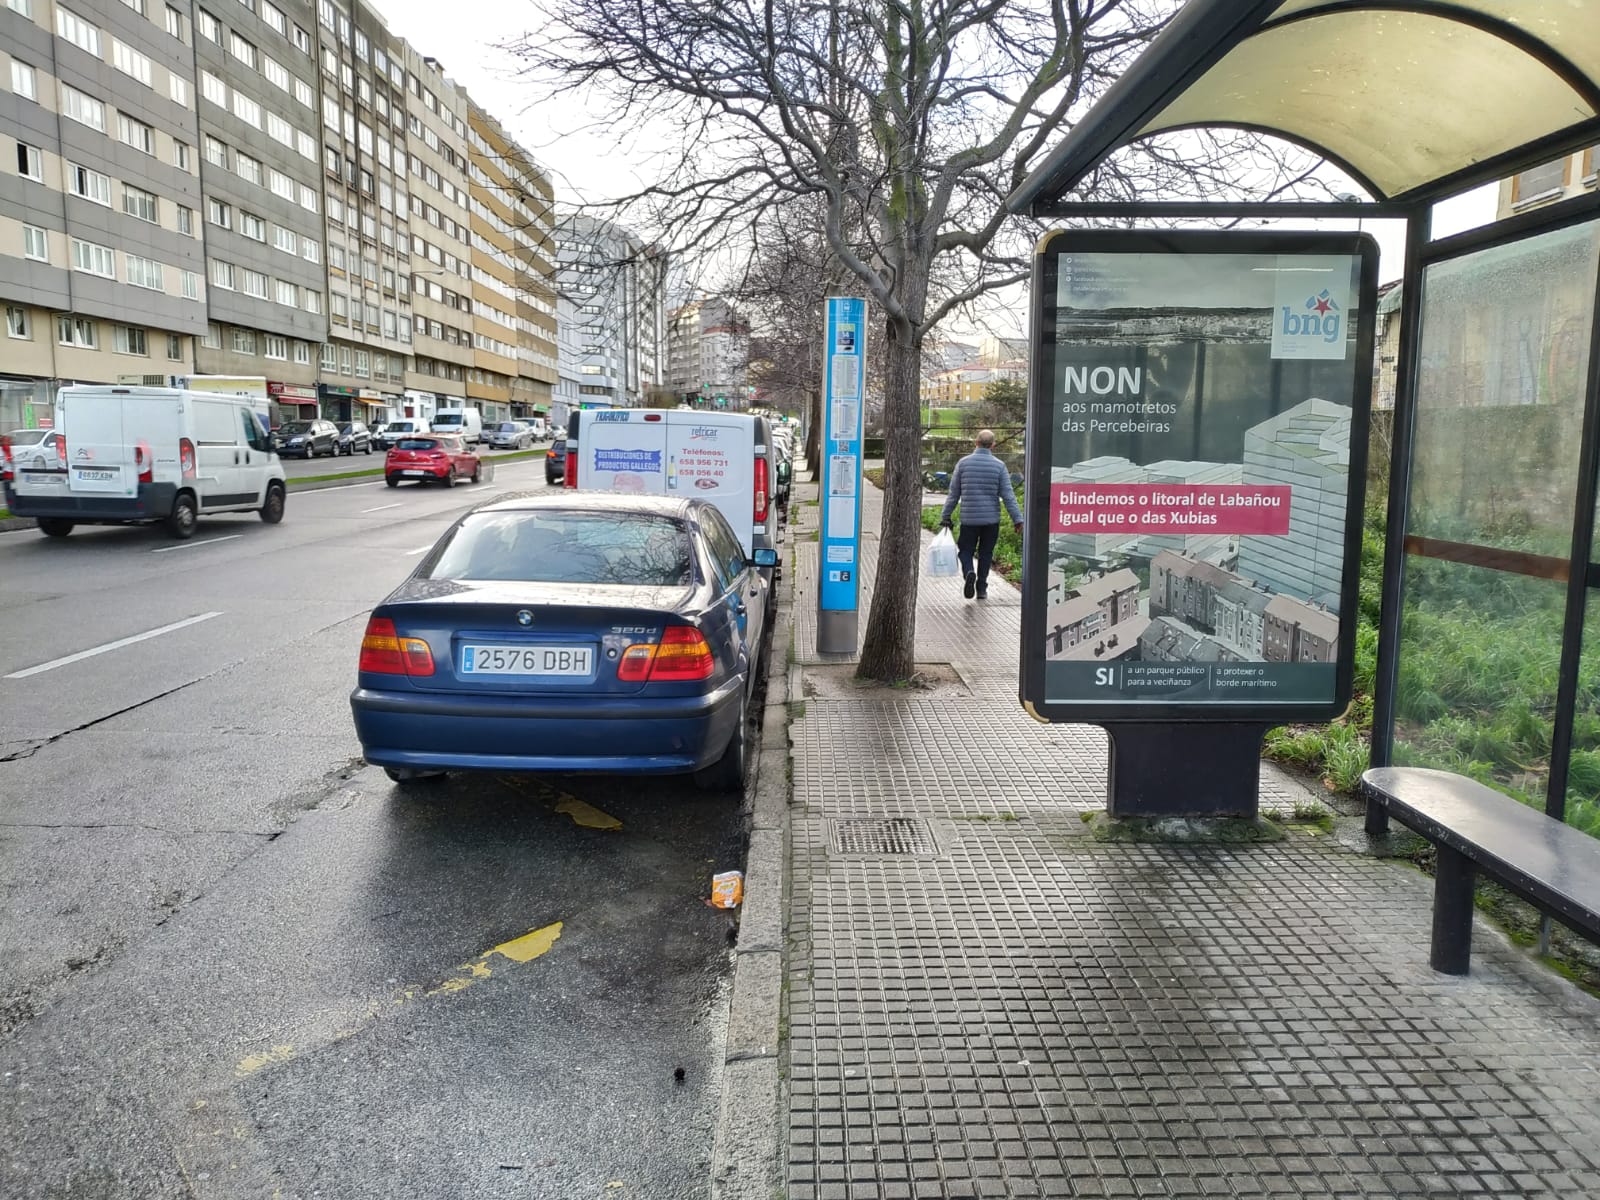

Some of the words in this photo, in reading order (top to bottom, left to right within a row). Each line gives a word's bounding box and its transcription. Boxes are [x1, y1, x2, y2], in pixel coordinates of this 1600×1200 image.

[1282, 306, 1340, 343] bng
[1064, 366, 1141, 394] NON
[1062, 402, 1087, 413] aos
[1090, 401, 1177, 414] mamotretos
[1061, 418, 1086, 432] das
[1089, 419, 1171, 433] Percebeiras
[1060, 491, 1135, 505] blindemos
[1139, 495, 1148, 505] o
[1152, 492, 1194, 505] litoral
[1198, 493, 1216, 506] de
[1220, 493, 1281, 507] Labañou
[1059, 510, 1094, 526] igual
[1097, 513, 1125, 526] que
[1128, 513, 1138, 524] o
[1141, 510, 1166, 524] das
[1170, 511, 1217, 524] Xubias
[478, 649, 536, 671] 2576
[543, 650, 587, 671] DBH
[1095, 667, 1114, 686] SI
[1146, 668, 1174, 676] parque
[1176, 666, 1205, 675] público
[1223, 668, 1256, 676] protexer
[1153, 678, 1192, 686] veciñanza
[1216, 679, 1240, 687] borde
